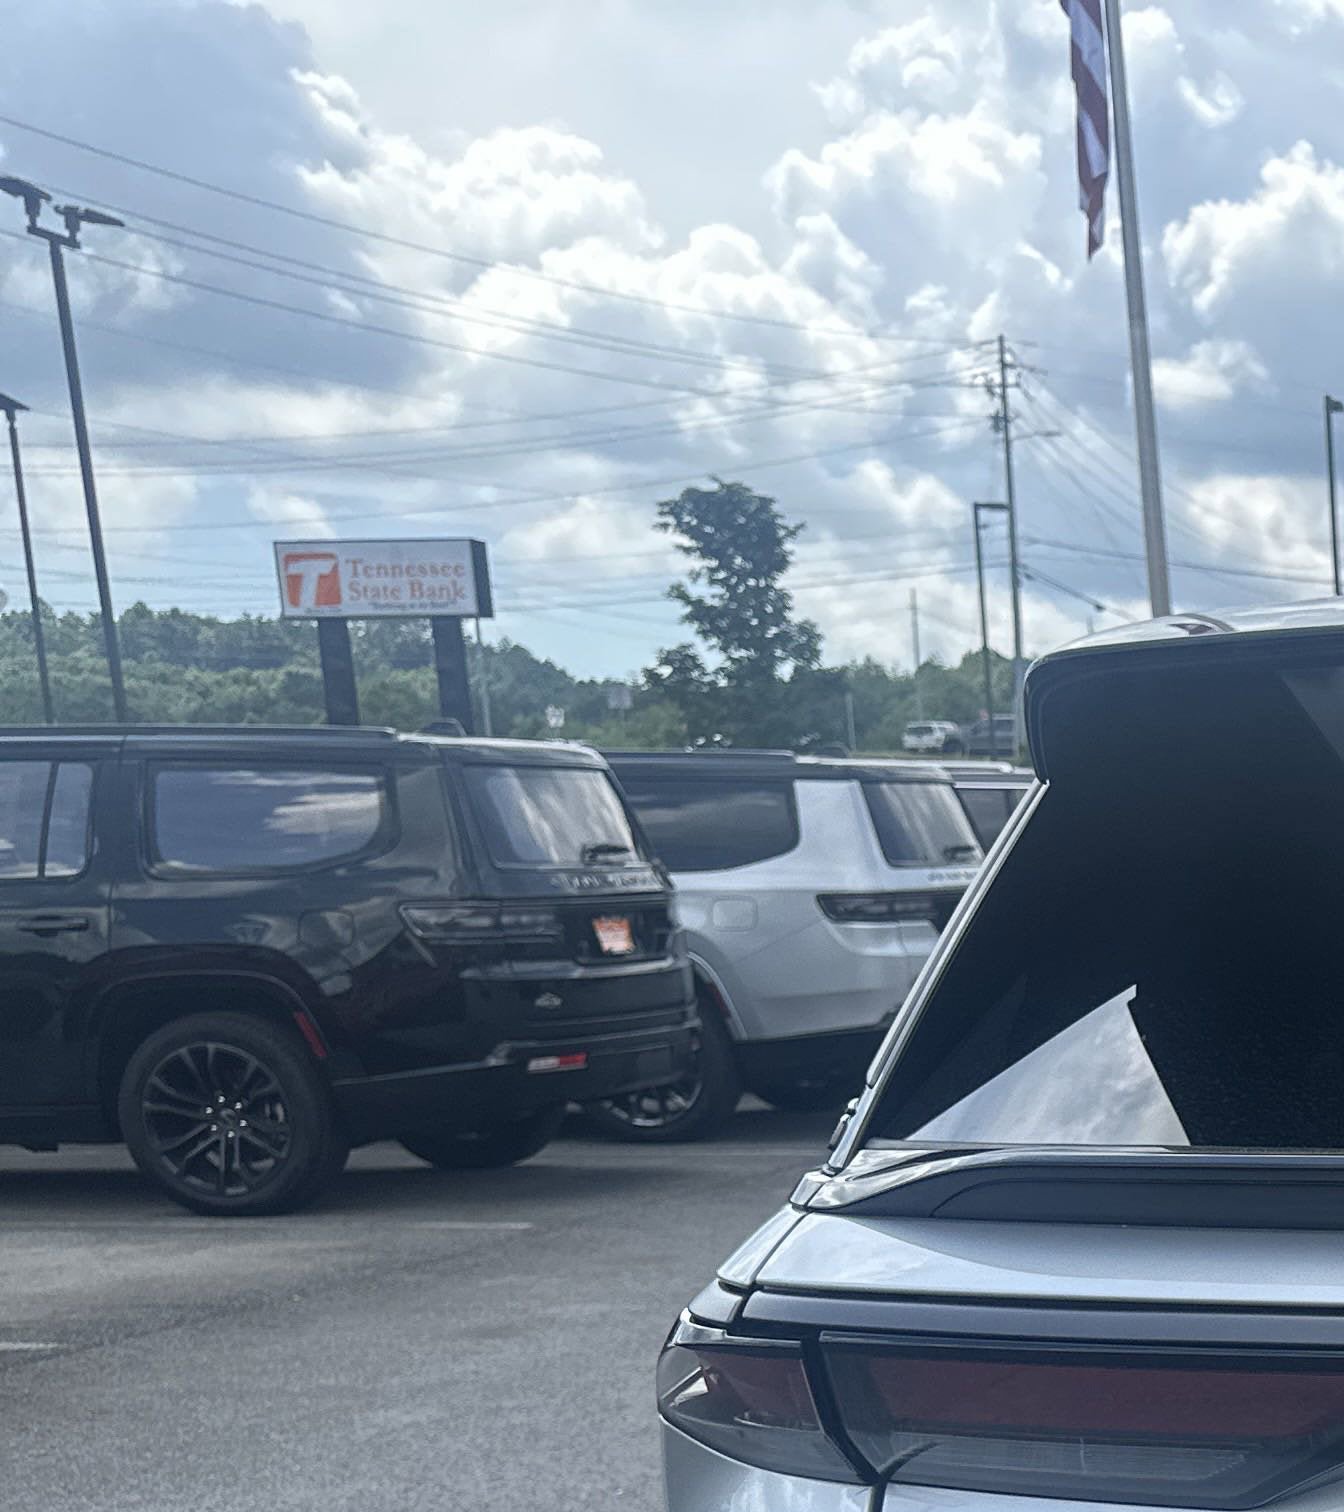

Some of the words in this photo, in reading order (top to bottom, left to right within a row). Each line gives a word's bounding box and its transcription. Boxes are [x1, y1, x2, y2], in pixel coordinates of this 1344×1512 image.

[346, 557, 465, 578] Tennessee
[348, 580, 400, 601] State
[408, 579, 465, 601] Bank
